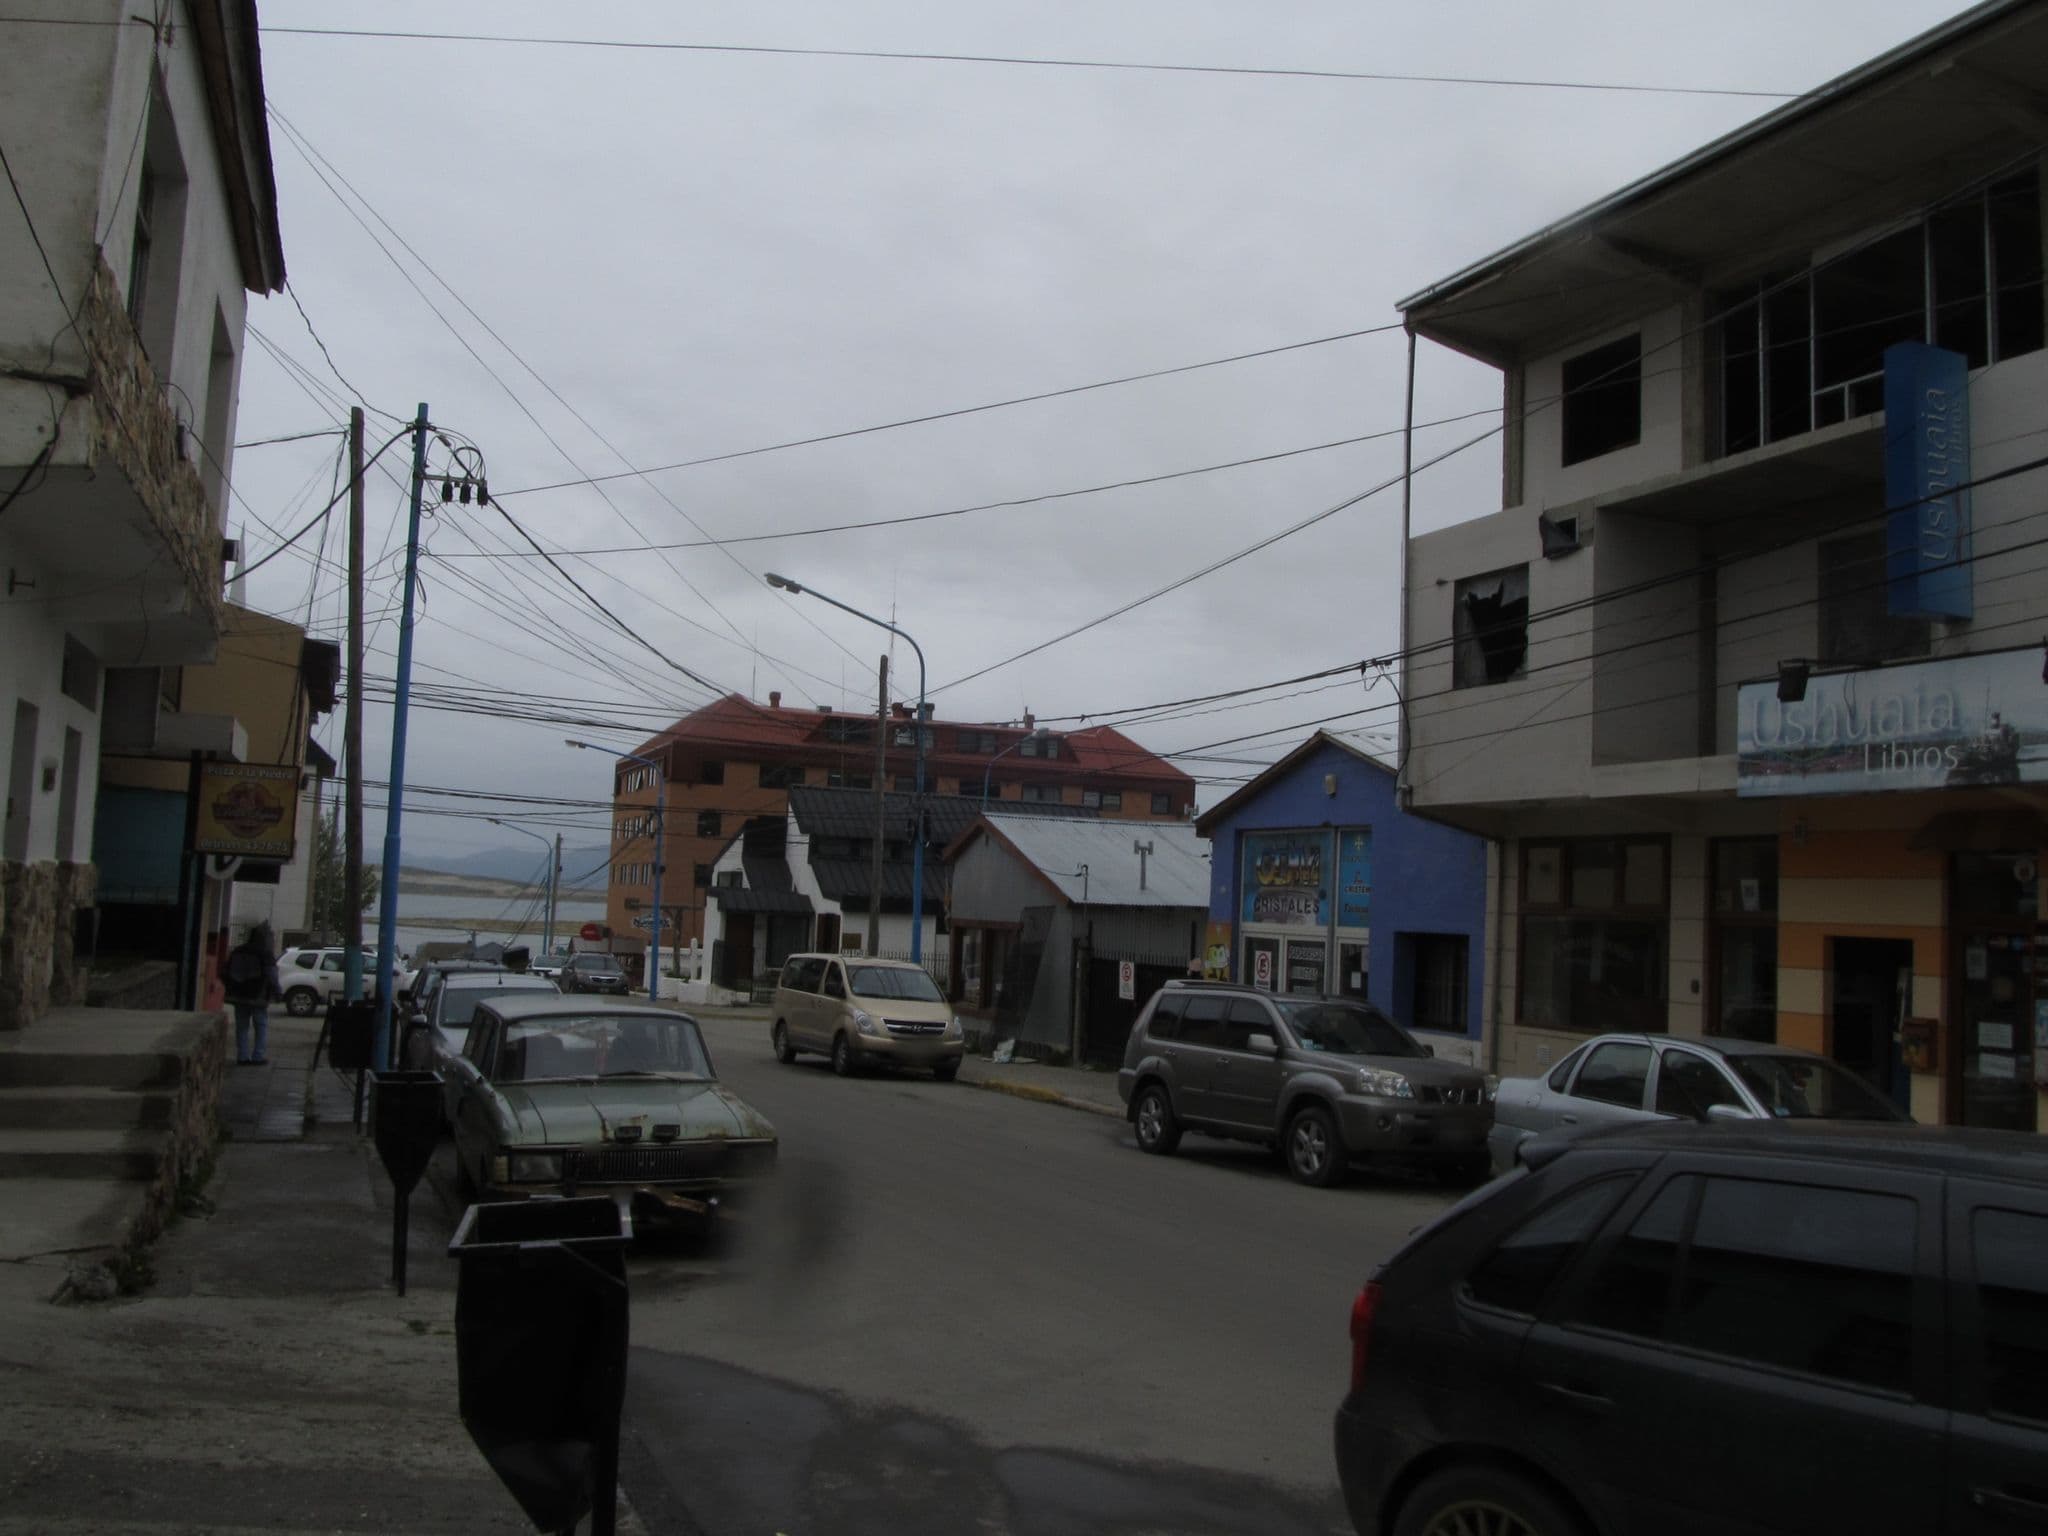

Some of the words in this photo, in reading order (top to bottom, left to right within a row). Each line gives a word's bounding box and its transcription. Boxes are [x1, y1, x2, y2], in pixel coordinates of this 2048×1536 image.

[1752, 683, 1961, 748] Ushuaia
[1864, 741, 1960, 776] Libros
[1253, 895, 1320, 914] CRISTALES
